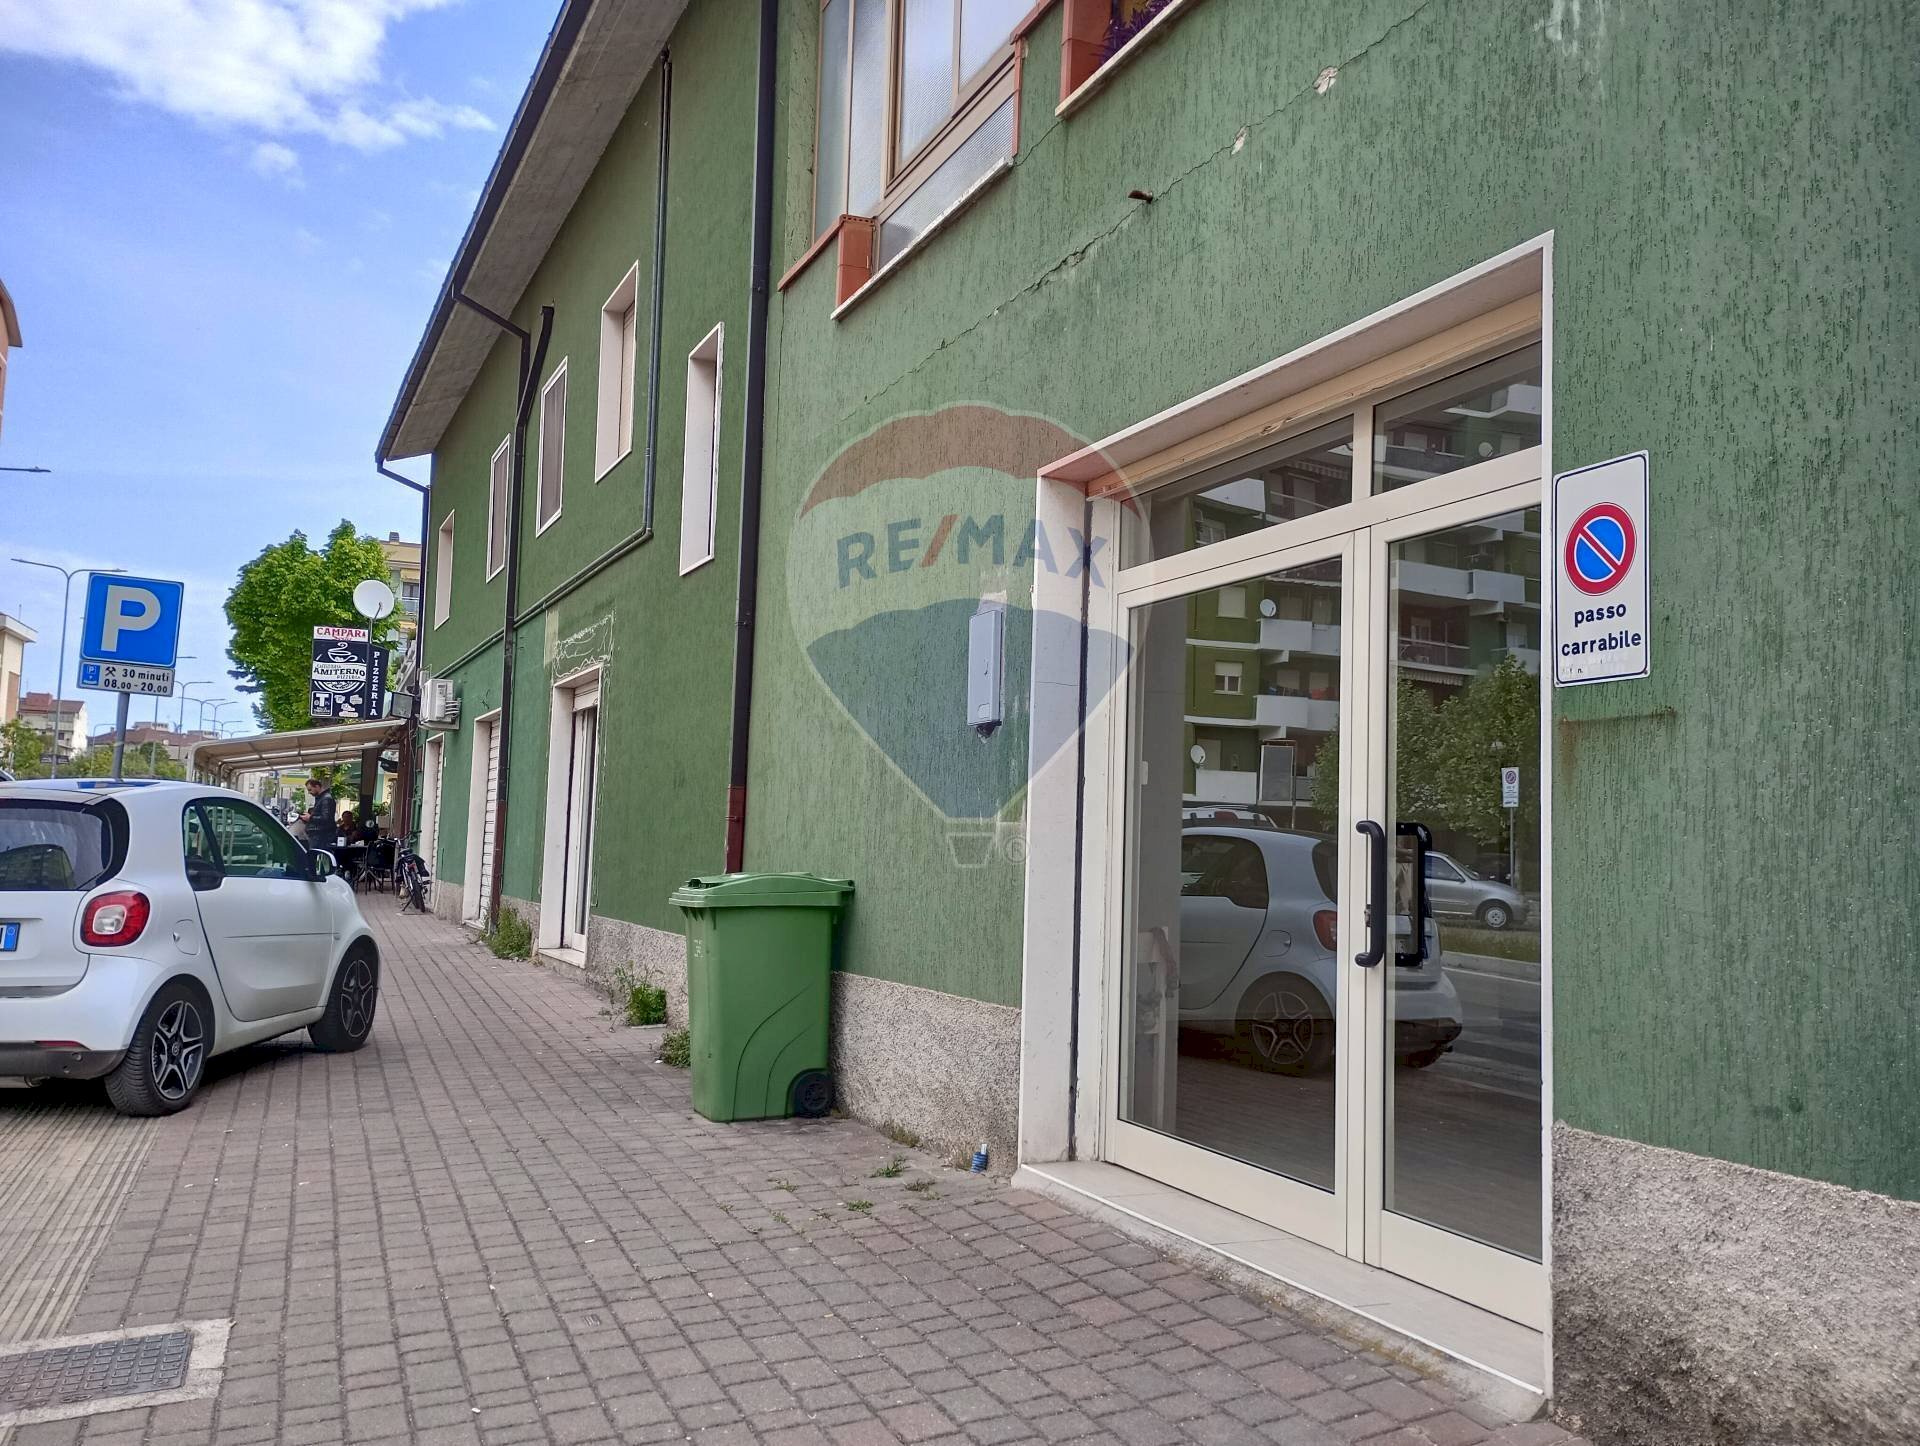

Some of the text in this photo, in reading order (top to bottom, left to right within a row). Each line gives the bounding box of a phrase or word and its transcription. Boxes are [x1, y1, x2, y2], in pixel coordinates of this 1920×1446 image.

[101, 585, 161, 652] P
[1574, 603, 1627, 627] passo
[1561, 630, 1642, 657] carrabile
[122, 668, 170, 682] 30 minuti
[313, 667, 366, 677] AMITERNO
[104, 678, 131, 690] 08.00
[141, 682, 168, 693] 20.00
[369, 651, 380, 716] PIZZERIA
[315, 693, 330, 706] T
